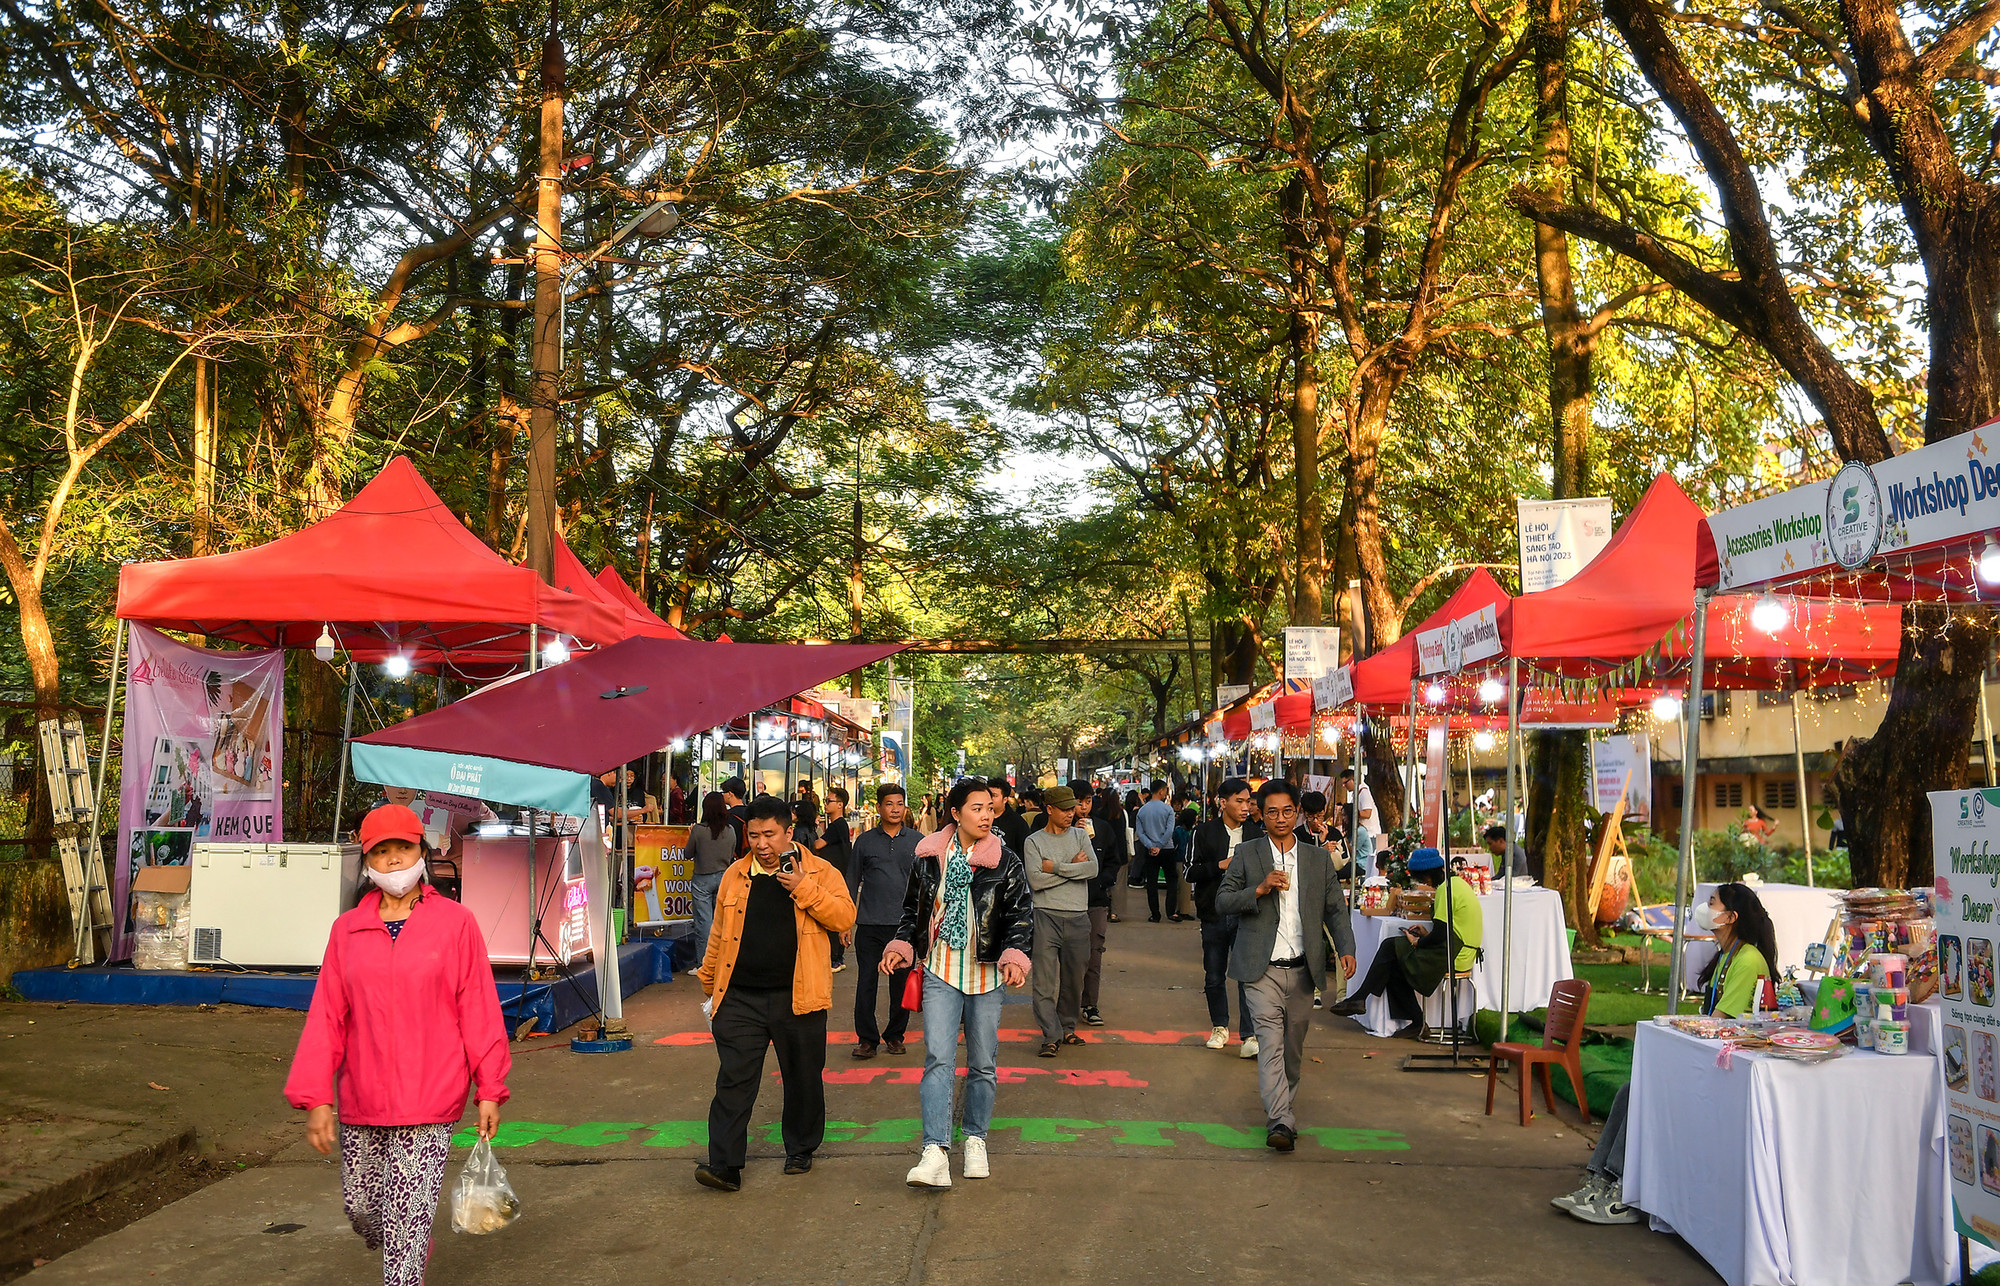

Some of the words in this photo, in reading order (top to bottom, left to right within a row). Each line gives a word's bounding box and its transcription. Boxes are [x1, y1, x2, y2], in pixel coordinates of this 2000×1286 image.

[1888, 471, 1969, 523] Workshop
[1726, 525, 1773, 558] Accessories
[1772, 512, 1822, 544] Workshop
[1838, 521, 1868, 537] CREATIVE
[1553, 551, 1572, 561] 2023
[215, 816, 240, 836] KEM
[242, 815, 272, 839] QUE
[661, 845, 694, 861] BÁN
[672, 864, 684, 876] 10
[1950, 840, 2000, 888] Workshop
[664, 880, 692, 893] WON
[1962, 893, 1993, 923] Decor
